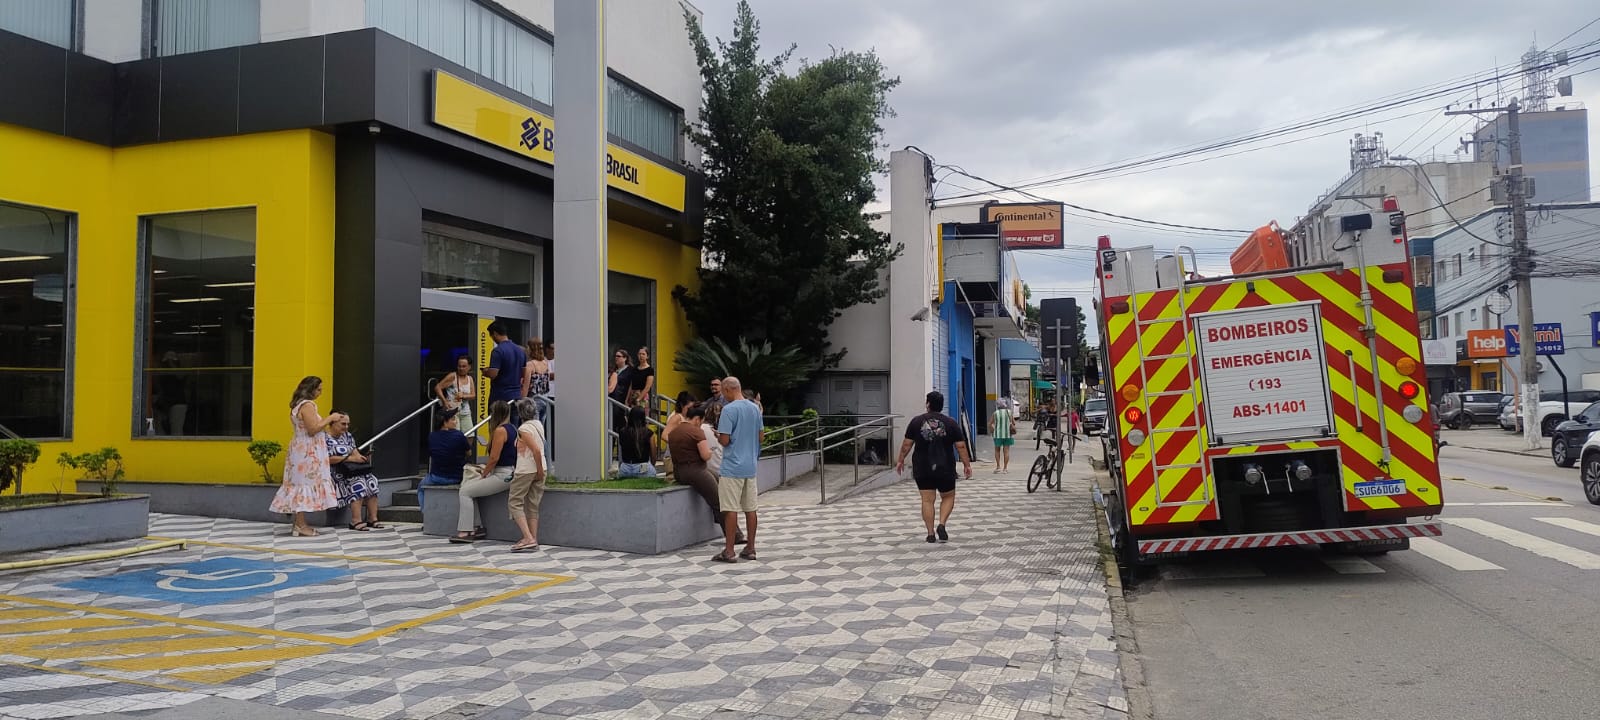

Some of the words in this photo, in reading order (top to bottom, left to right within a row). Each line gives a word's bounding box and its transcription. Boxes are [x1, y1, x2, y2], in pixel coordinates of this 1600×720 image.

[606, 153, 639, 184] BRASIL
[995, 211, 1046, 222] Continental
[1207, 318, 1308, 342] BOMBEIROS
[1508, 328, 1561, 344] Ymi
[1473, 336, 1506, 351] help
[1211, 349, 1312, 369] EMERGÊNCIA
[1233, 400, 1306, 418] ABS-11401
